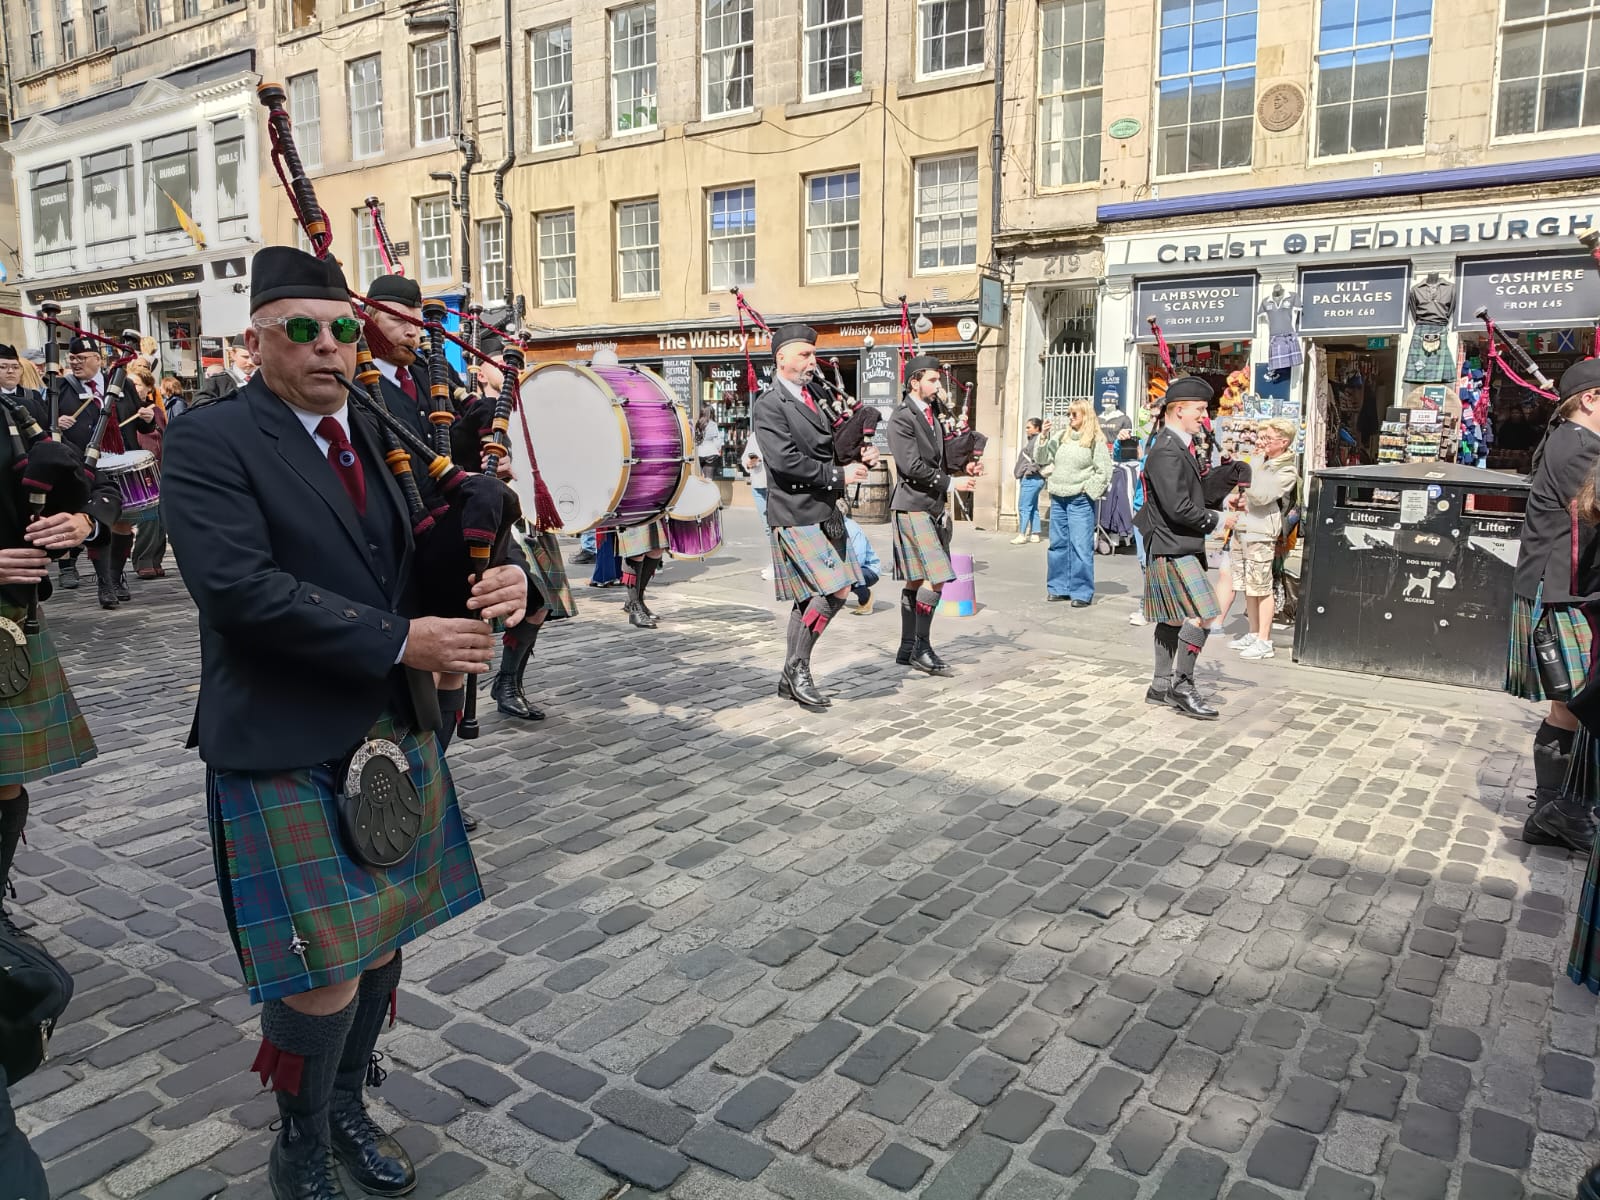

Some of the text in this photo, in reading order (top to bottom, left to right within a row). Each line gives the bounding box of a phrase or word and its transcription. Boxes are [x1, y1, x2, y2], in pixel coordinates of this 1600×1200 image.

[218, 152, 239, 165] GRILLS
[159, 165, 186, 179] BURGERS
[93, 183, 112, 194] PIZZAS
[40, 193, 67, 207] COCKTAILS
[1157, 214, 1593, 263] CREST OF EDINBURGH
[1043, 254, 1081, 275] 219
[1488, 269, 1584, 284] CASHMERE
[51, 287, 72, 300] THE
[79, 280, 119, 297] FILLING
[128, 272, 174, 290] STATION
[1336, 281, 1370, 292] KILT
[1495, 282, 1574, 296] SCARVES
[1151, 287, 1240, 302] LAMBSWOOL
[1312, 292, 1392, 304] PACKAGES
[1164, 299, 1225, 312] SCARVES
[1503, 299, 1563, 310] FROM £45
[1323, 308, 1375, 317] FROM £60
[1165, 315, 1225, 326] FROM £12.99
[839, 325, 872, 337] Whisky
[657, 333, 686, 350] The
[689, 330, 749, 351] Whisky
[866, 357, 892, 370] LOST
[666, 367, 689, 377] SCOTCH
[711, 367, 741, 380] Single
[715, 381, 738, 391] Malt
[1350, 512, 1380, 523] Litter
[1478, 521, 1511, 532] Litter
[1404, 597, 1435, 605] ACCEPTED
